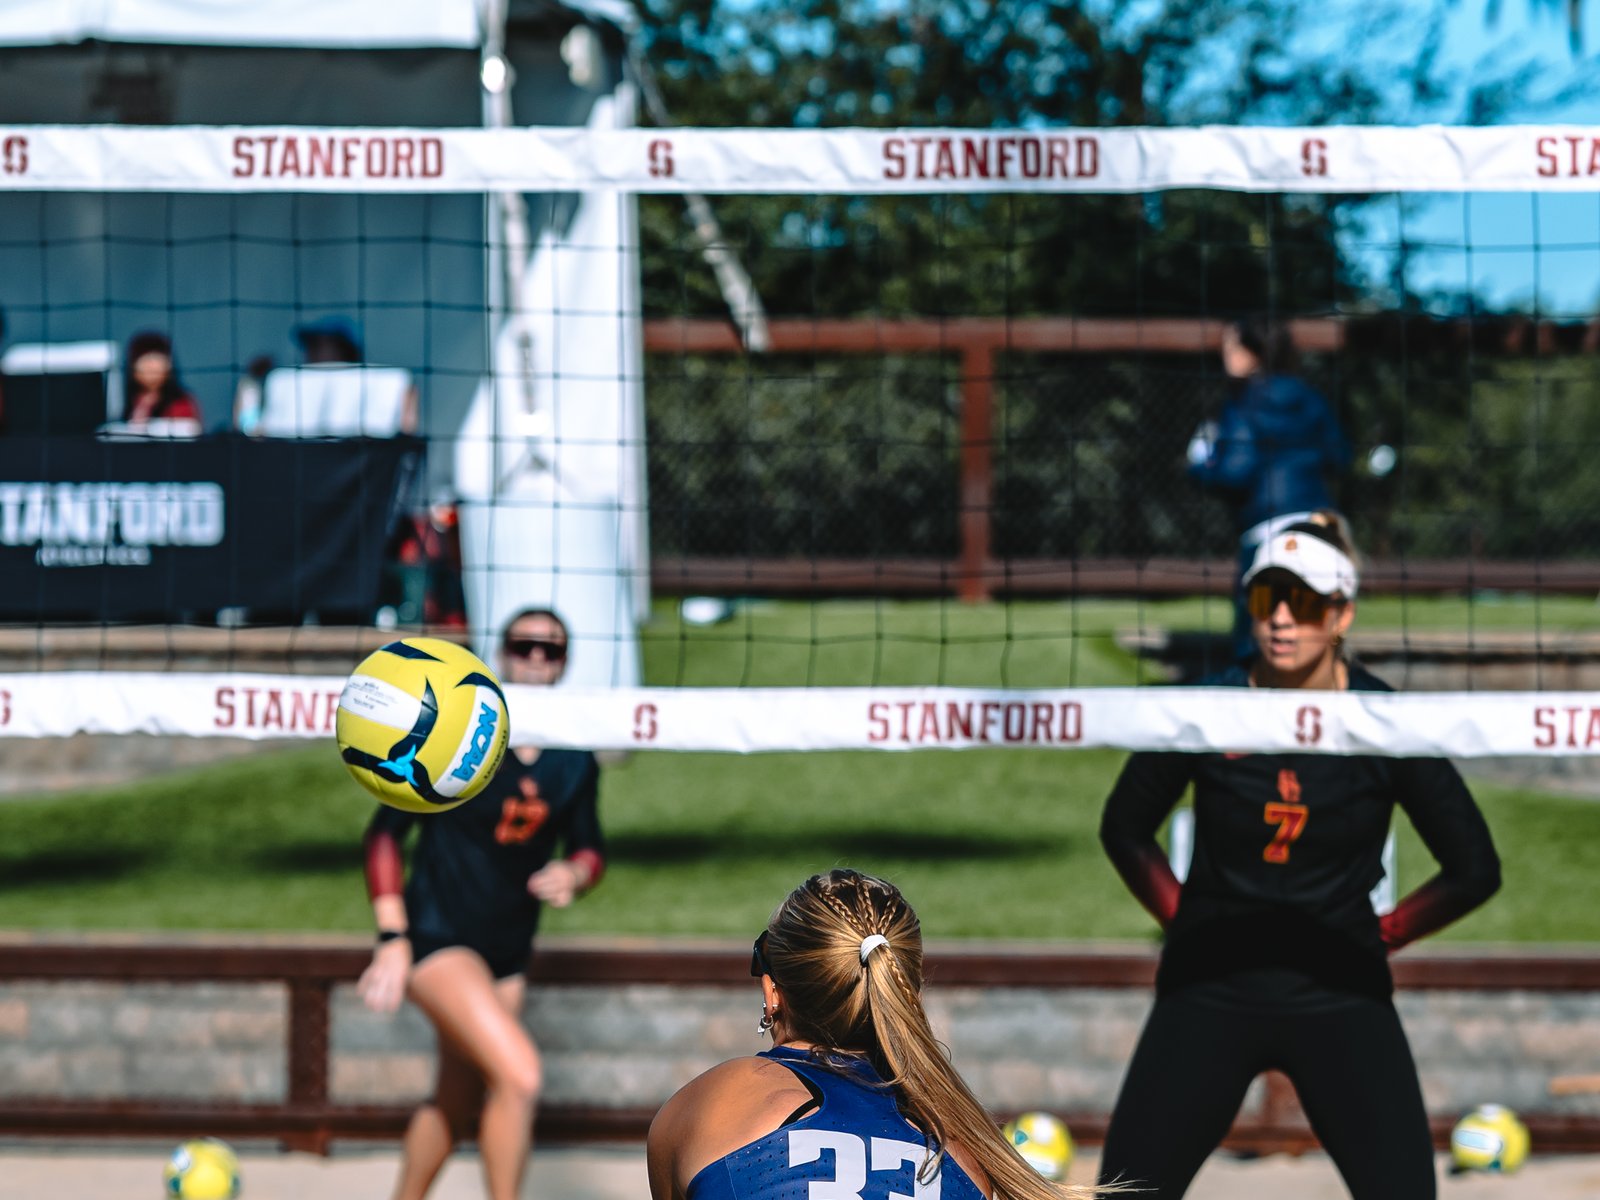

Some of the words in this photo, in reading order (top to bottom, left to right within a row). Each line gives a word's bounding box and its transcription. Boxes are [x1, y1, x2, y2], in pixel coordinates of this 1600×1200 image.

[3, 135, 29, 175] S
[232, 135, 443, 179] STANFORD
[648, 139, 674, 178] S
[883, 136, 1099, 179] STANFORD
[1300, 138, 1328, 177] S
[451, 701, 499, 783] NCAA
[632, 703, 658, 741] S
[867, 701, 1084, 743] STANFORD
[1295, 705, 1322, 745] S
[1263, 802, 1309, 863] 7
